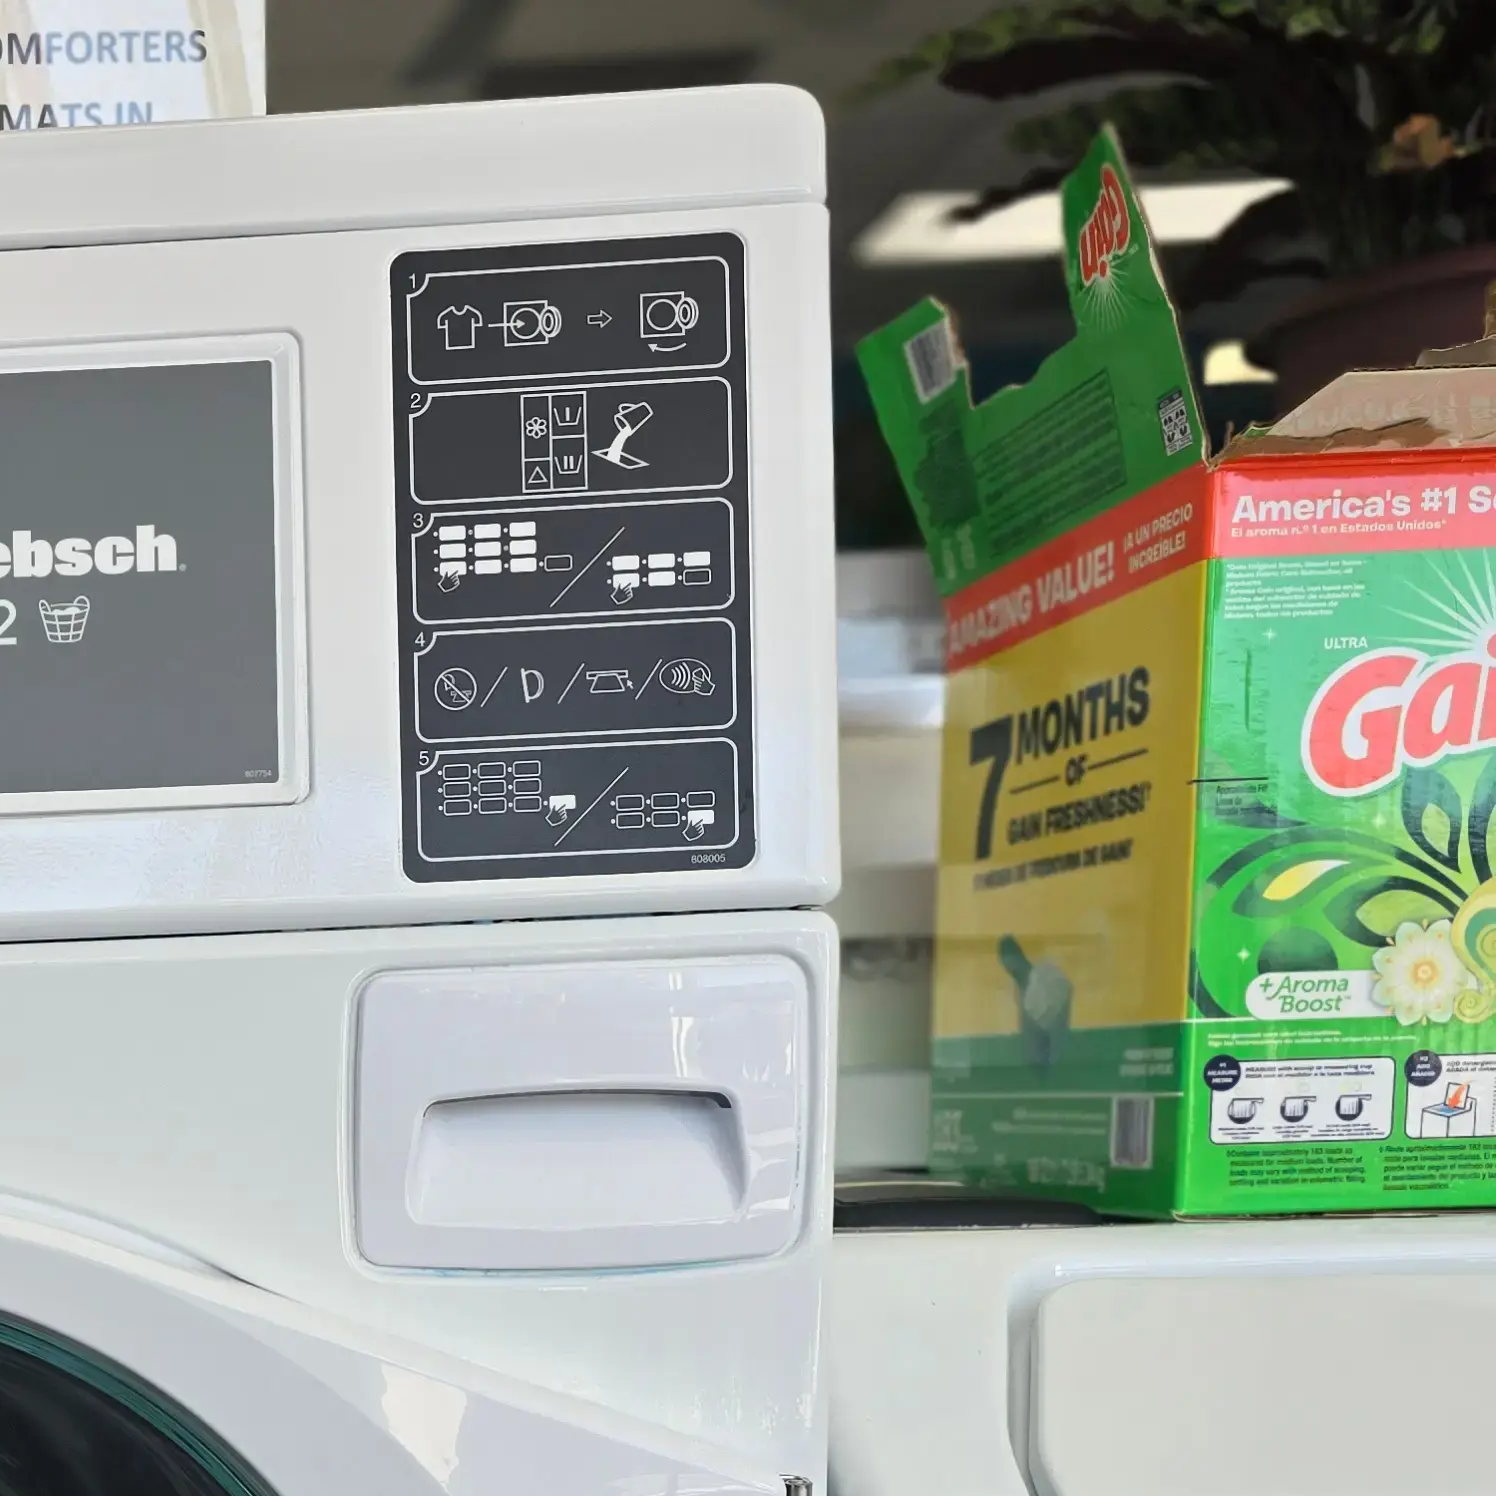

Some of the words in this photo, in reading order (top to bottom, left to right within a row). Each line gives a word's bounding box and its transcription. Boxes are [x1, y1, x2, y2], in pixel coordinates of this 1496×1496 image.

[115, 102, 153, 125] IN
[409, 274, 416, 289] 1
[410, 392, 421, 408] 2
[1232, 490, 1410, 523] America's
[1421, 487, 1456, 514] #1
[1468, 485, 1496, 514] S
[412, 513, 424, 528] 3
[1135, 523, 1149, 545] UN
[1152, 502, 1193, 537] PRECIO
[1231, 528, 1243, 537] El
[1245, 527, 1288, 537] aroma
[1321, 524, 1337, 534] en
[1341, 522, 1394, 533] Estados
[949, 583, 1034, 654] AMAZING
[1036, 540, 1115, 614] VALUE!
[414, 632, 426, 647] 4
[1324, 636, 1368, 649] ULTRA
[418, 751, 430, 766] 5
[969, 714, 1013, 861] 7
[1016, 665, 1149, 766] MONTHS
[1065, 753, 1089, 786] OF
[1007, 809, 1042, 846] GAIN
